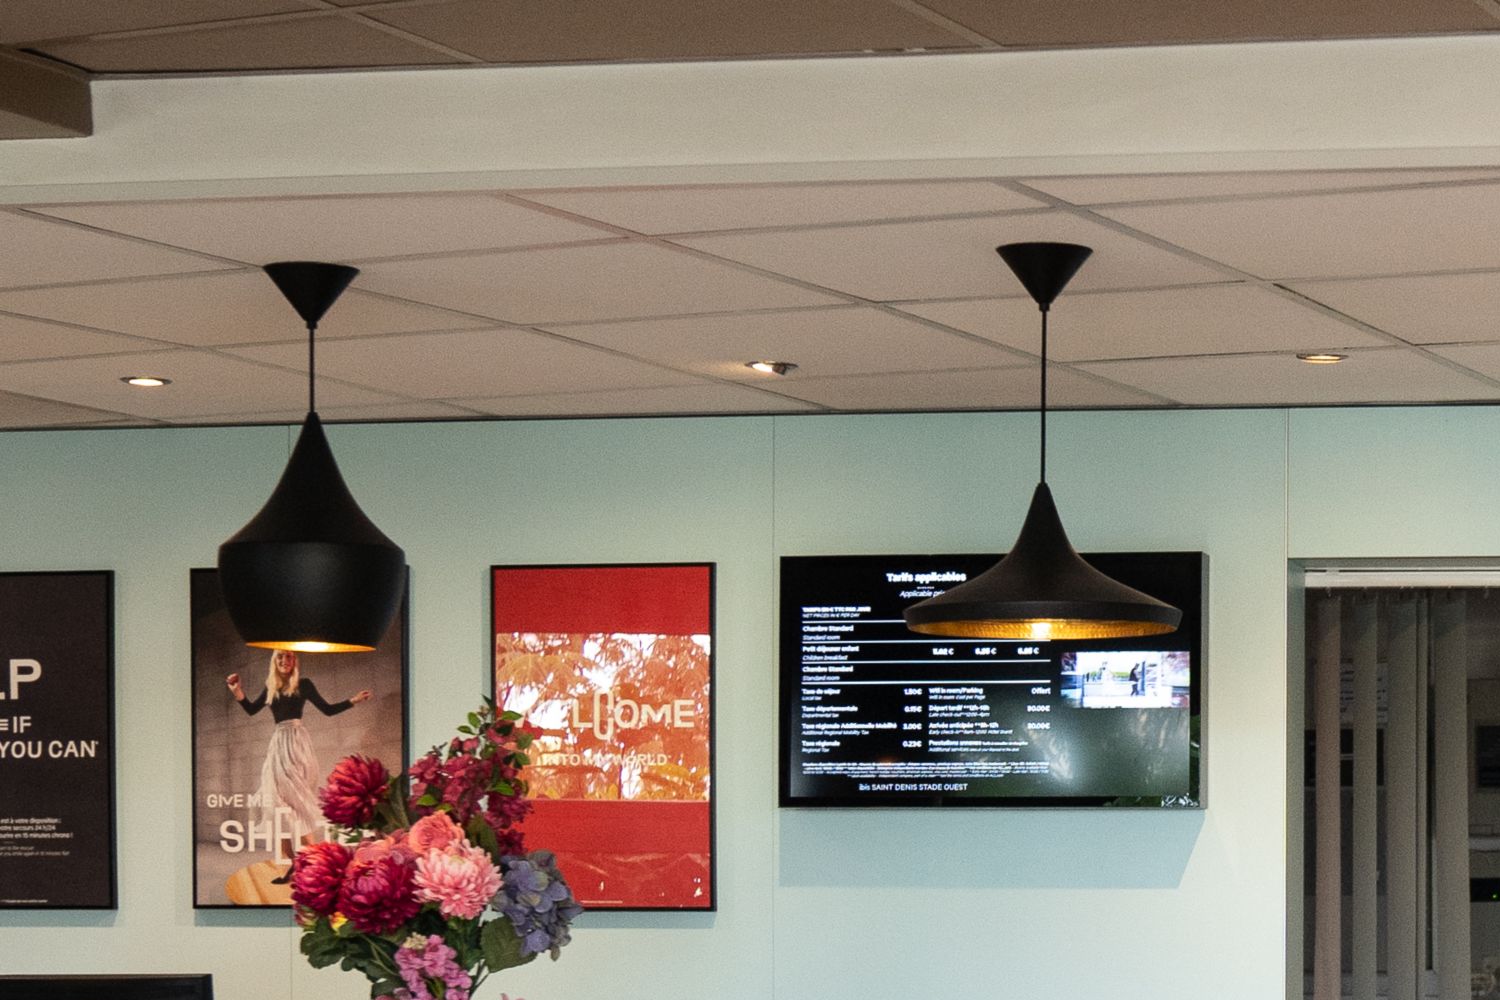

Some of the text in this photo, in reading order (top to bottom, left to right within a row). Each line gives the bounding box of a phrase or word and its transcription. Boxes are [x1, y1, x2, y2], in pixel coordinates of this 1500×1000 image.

[886, 572, 967, 583] Tarifs applicables
[13, 716, 32, 734] IF
[0, 741, 42, 759] YOU
[872, 783, 893, 791] SAINT
[895, 783, 917, 791] DENIS
[919, 783, 942, 791] STADE
[207, 794, 244, 808] GIVE
